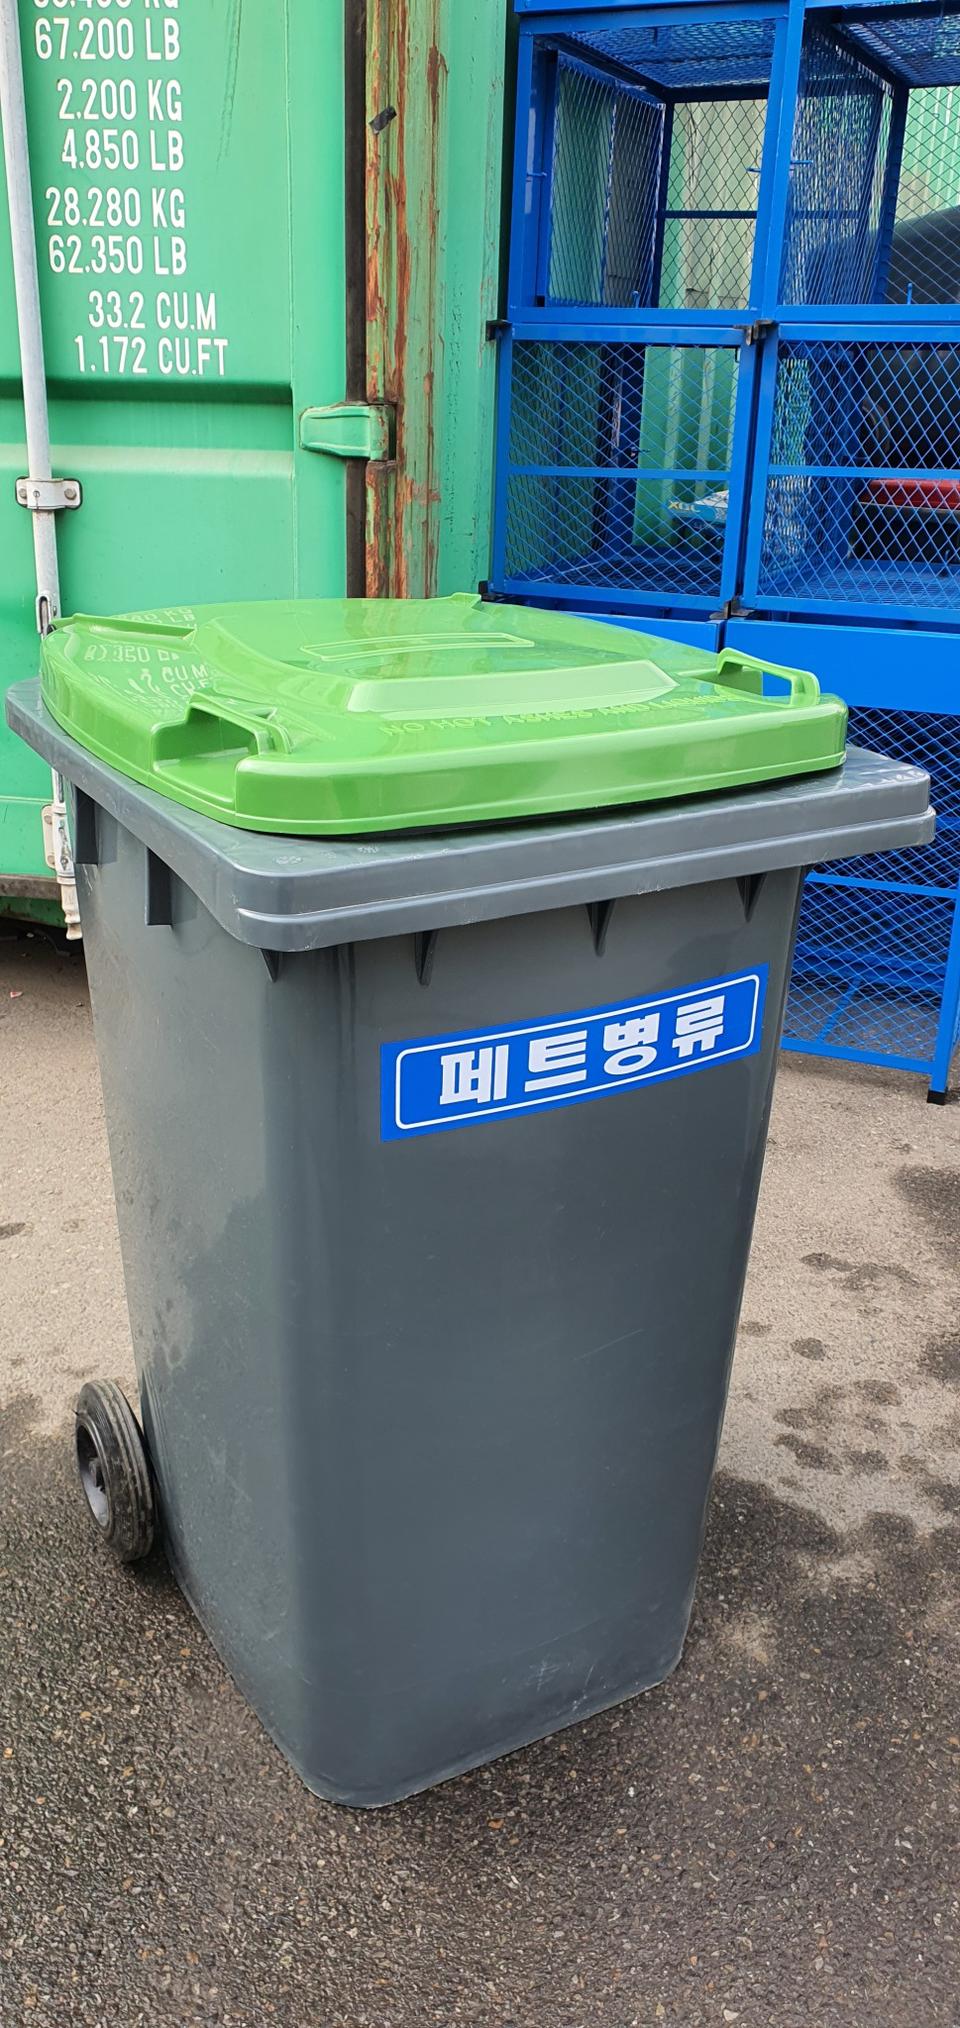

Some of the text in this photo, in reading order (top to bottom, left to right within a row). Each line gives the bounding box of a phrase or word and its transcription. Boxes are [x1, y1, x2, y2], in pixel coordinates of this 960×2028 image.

[35, 18, 180, 60] 67.200 LB
[57, 79, 182, 121] 2.200 KG
[62, 129, 184, 171] 4.850 LB
[46, 187, 185, 228] 28.280 KG
[49, 235, 187, 275] 62.350 LB
[88, 291, 216, 330] 33.2 CU.M
[75, 336, 228, 375] 1.172 CU.FT
[379, 721, 425, 736] NO
[430, 716, 492, 730] HOT
[439, 995, 725, 1105] 페트병류
